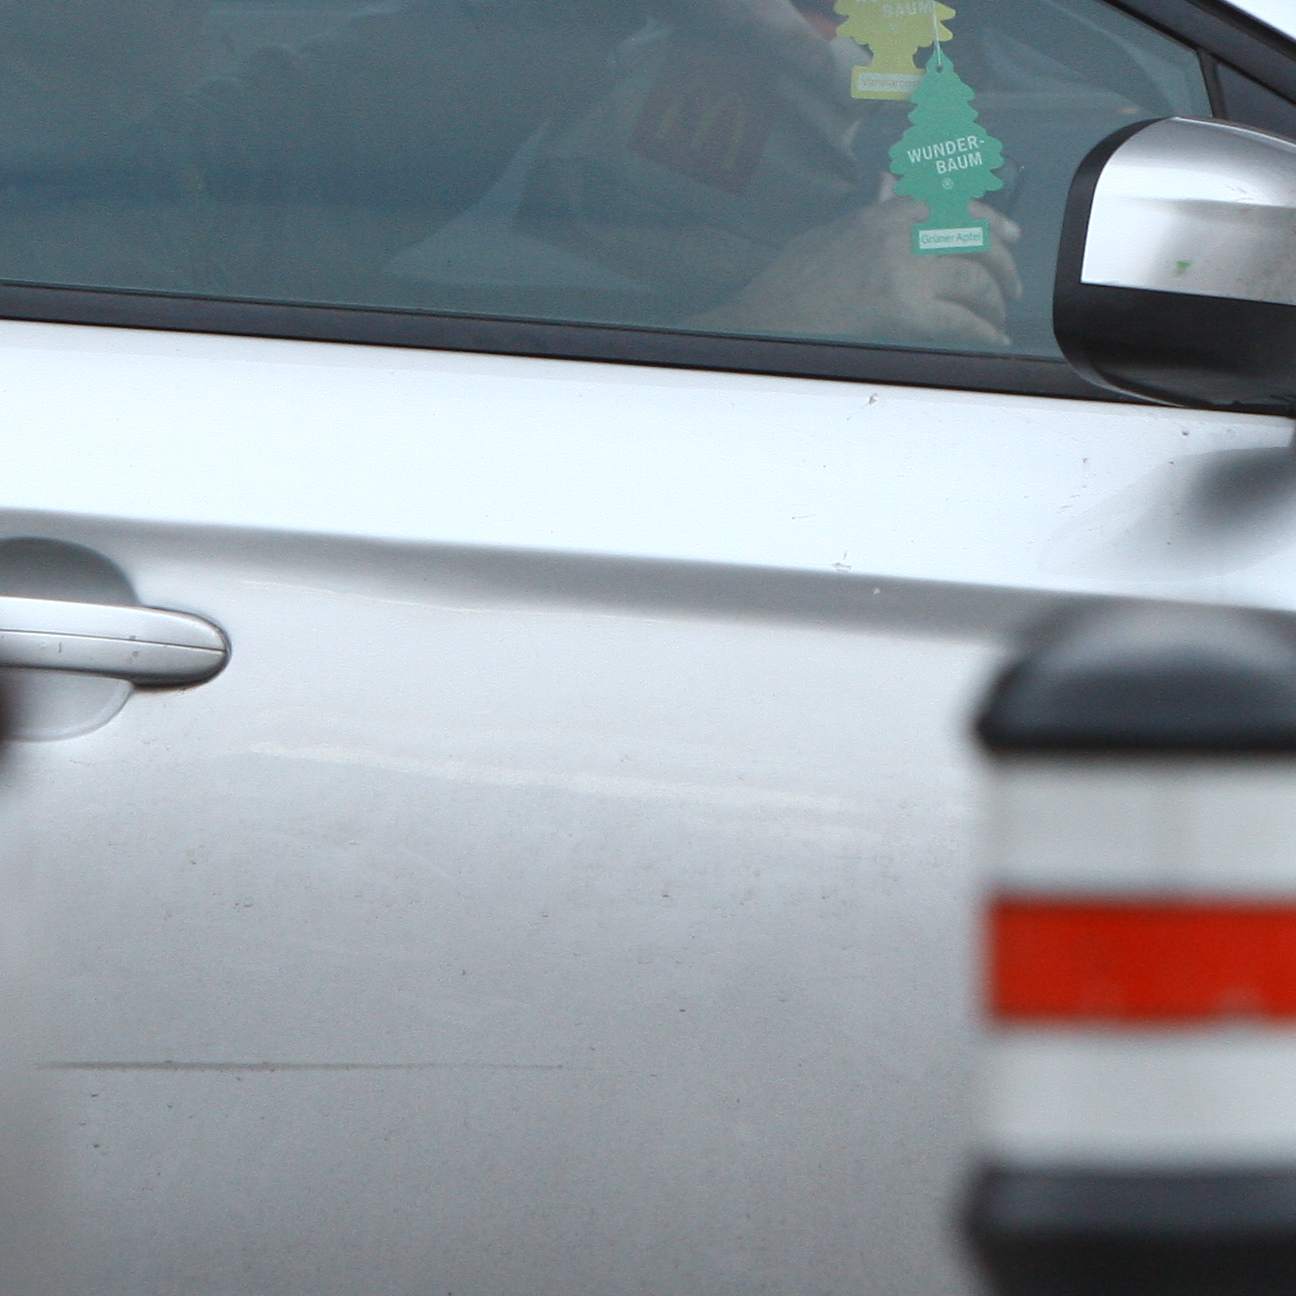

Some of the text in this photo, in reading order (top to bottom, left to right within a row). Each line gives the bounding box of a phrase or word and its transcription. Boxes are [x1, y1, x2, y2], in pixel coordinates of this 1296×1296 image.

[883, 0, 935, 18] BAUM
[907, 135, 985, 163] WUNDER-
[935, 152, 983, 174] BAUM
